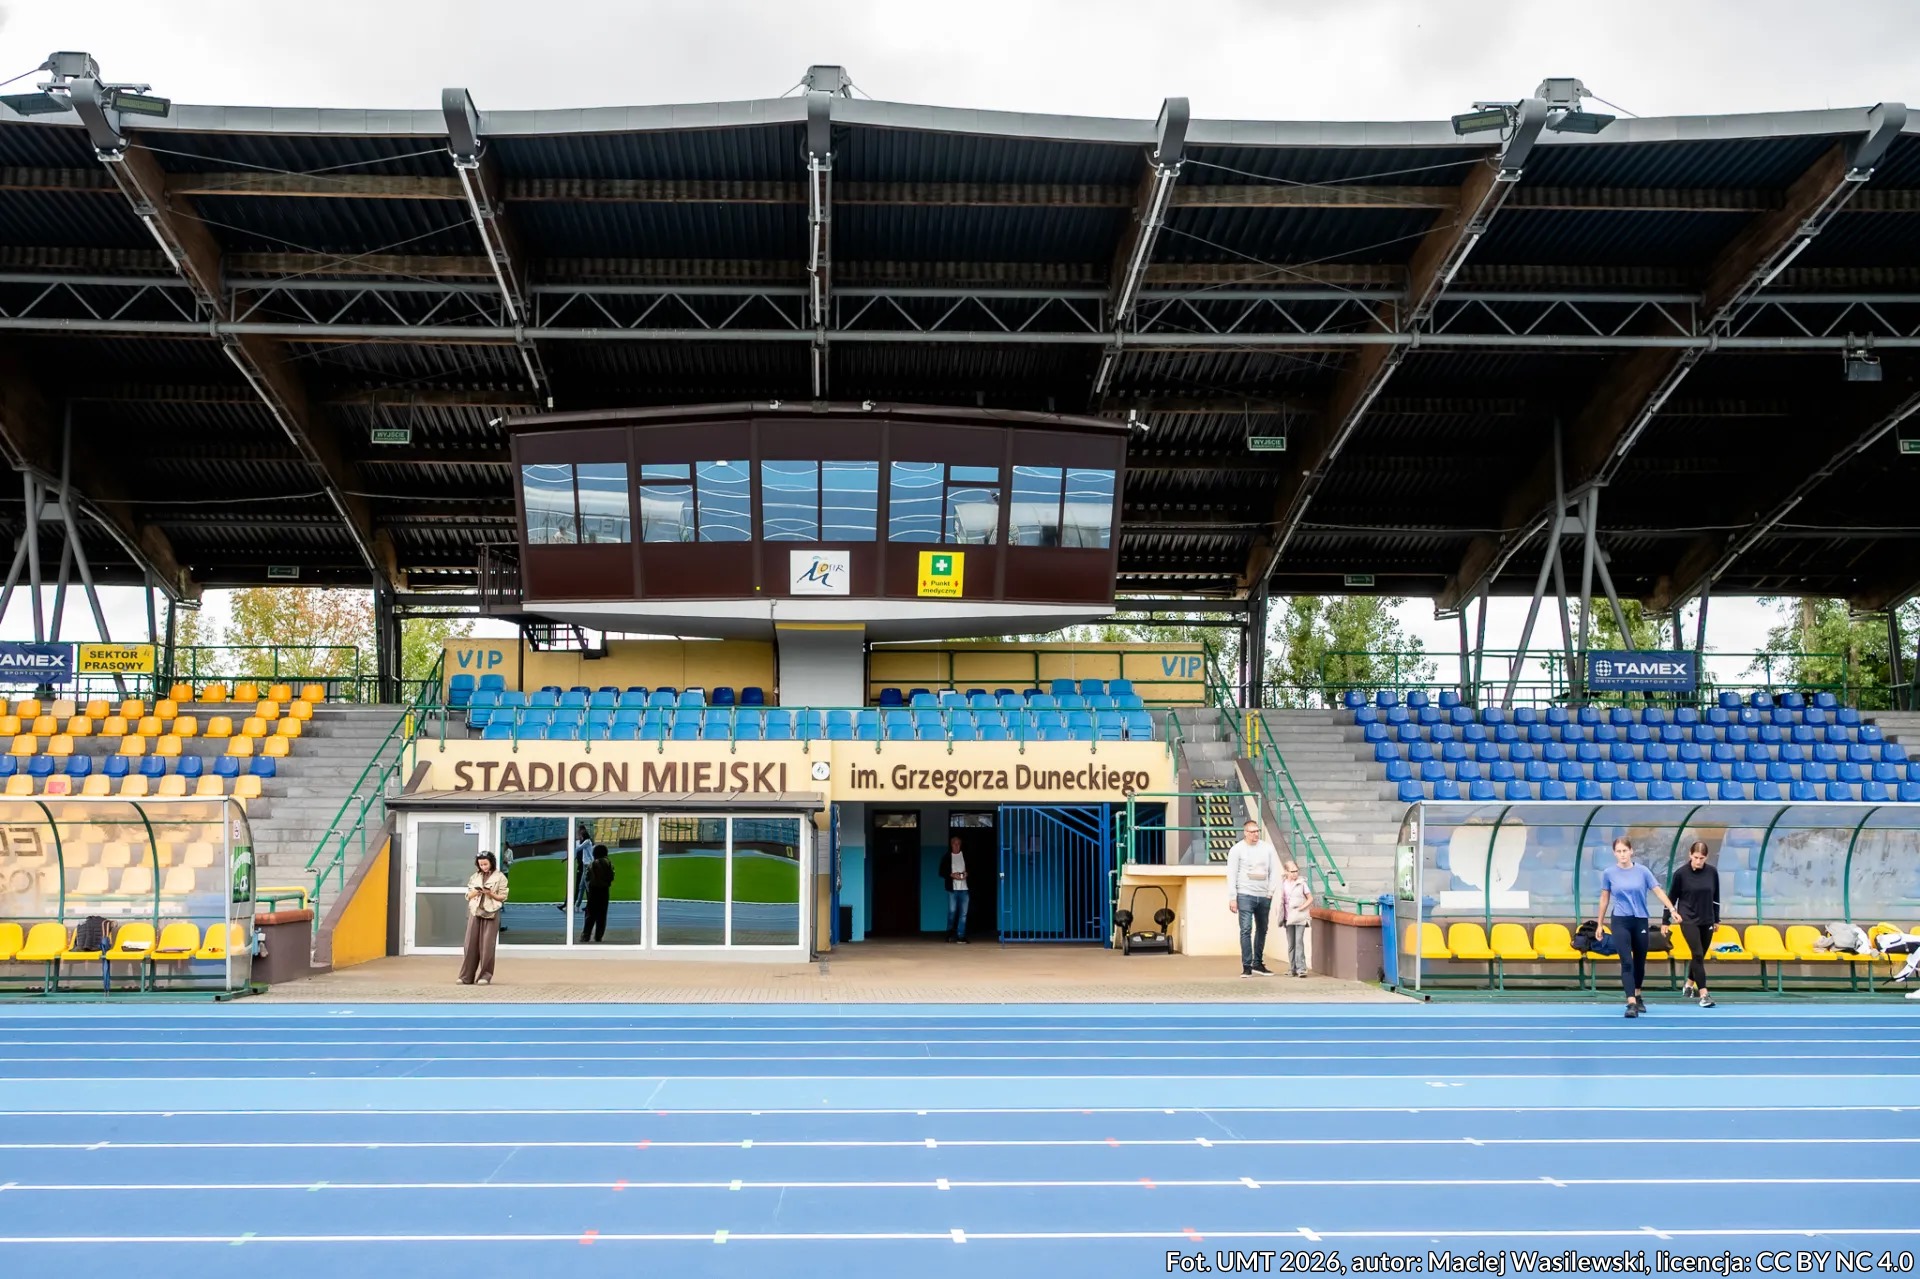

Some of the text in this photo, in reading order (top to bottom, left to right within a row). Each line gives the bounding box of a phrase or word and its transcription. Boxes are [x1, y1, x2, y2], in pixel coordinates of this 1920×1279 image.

[0, 654, 65, 667] AMEX
[89, 650, 138, 659] SEKTOR
[457, 649, 503, 669] VIP
[84, 661, 144, 670] PRASOWY
[1161, 655, 1202, 678] VIP
[1613, 662, 1687, 675] TAMEX
[454, 760, 787, 793] STADION MIEJSKI
[850, 762, 1150, 797] im. Grzegorza Duneckiego
